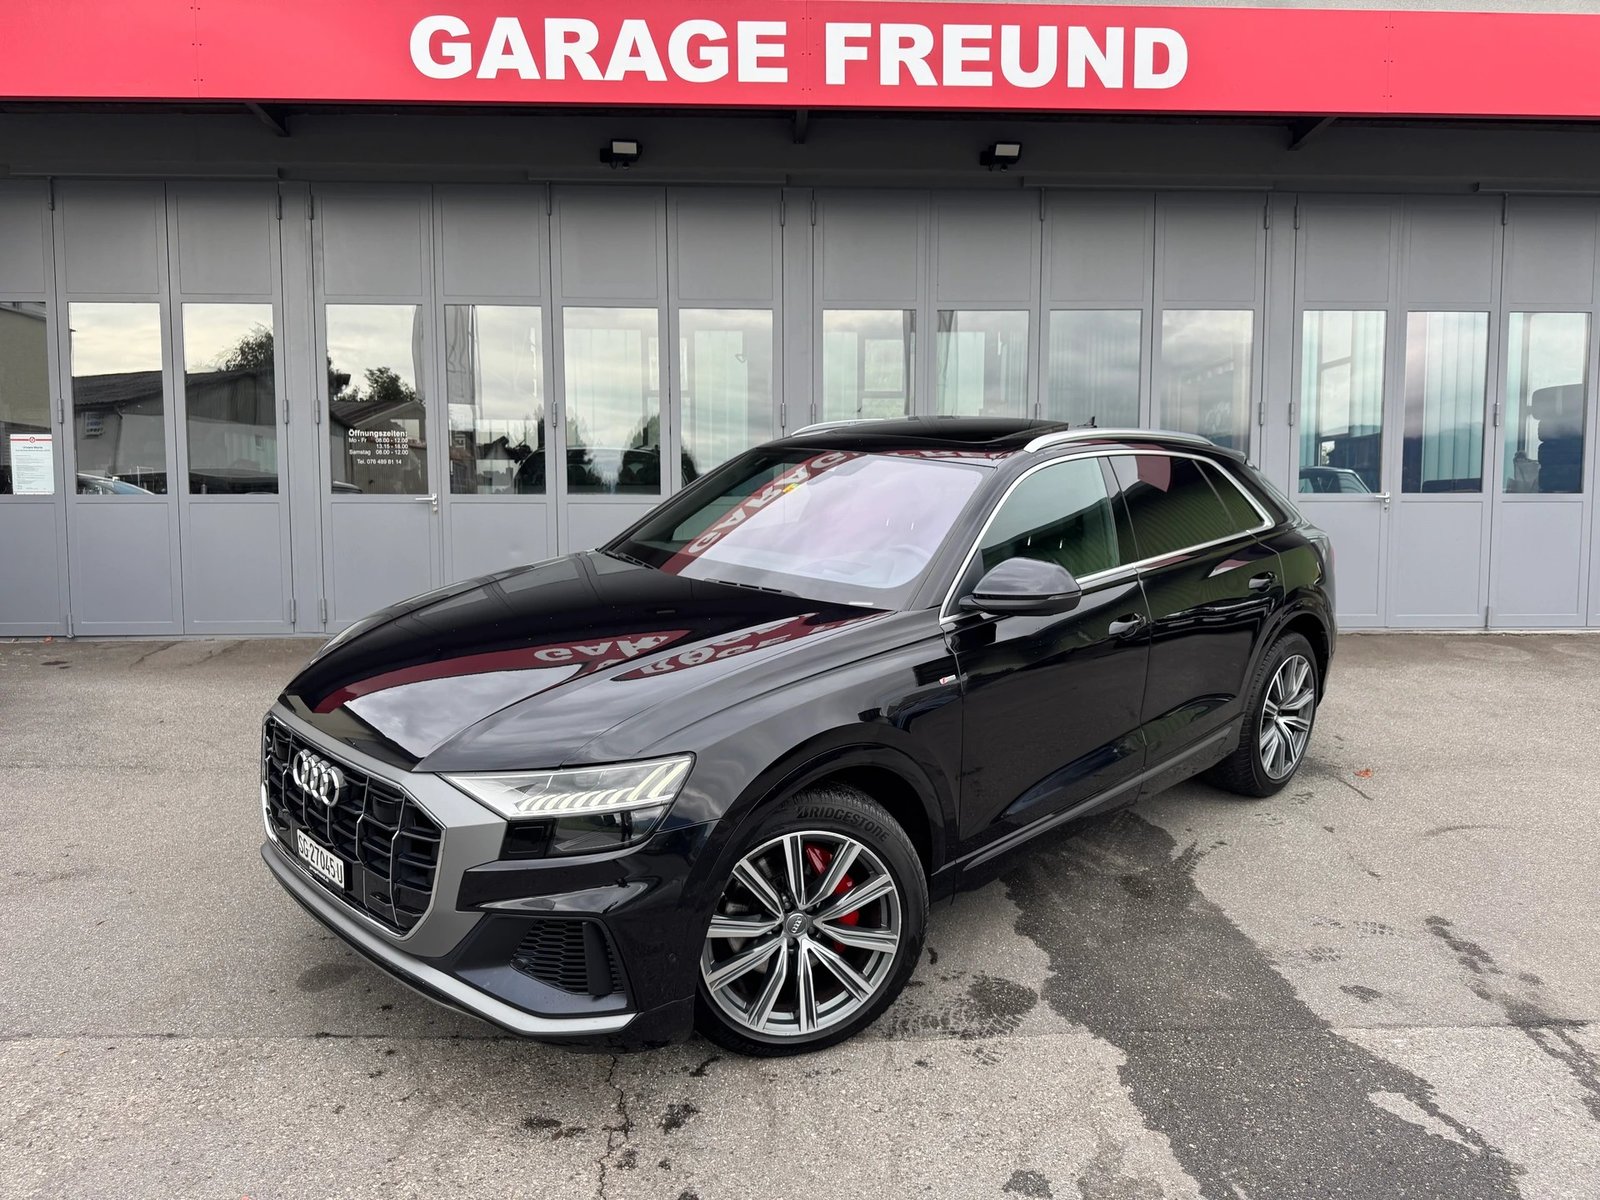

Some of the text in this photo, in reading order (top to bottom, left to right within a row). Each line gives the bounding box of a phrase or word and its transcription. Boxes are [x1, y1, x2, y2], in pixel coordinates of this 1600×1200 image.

[409, 15, 1188, 89] GARAGE FREUND
[349, 429, 407, 438] Öffnungszeiten:
[797, 805, 890, 842] BRIDGESTONE
